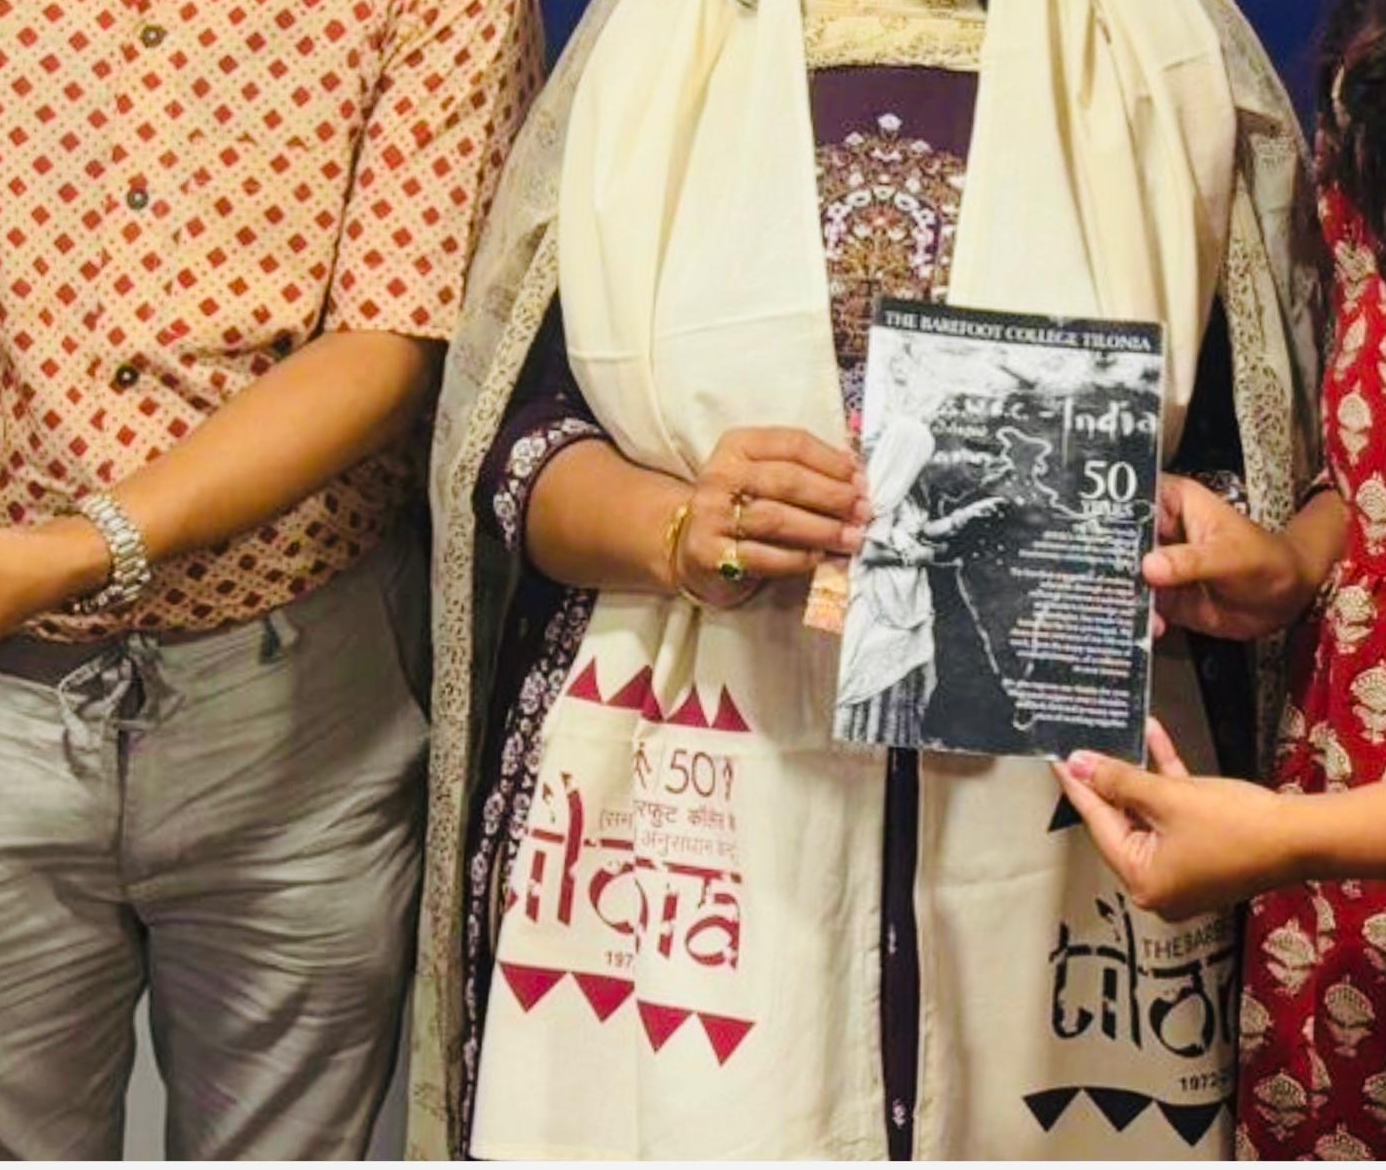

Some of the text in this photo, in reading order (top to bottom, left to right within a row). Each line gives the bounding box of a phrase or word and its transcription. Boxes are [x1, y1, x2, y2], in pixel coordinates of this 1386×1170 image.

[885, 310, 1152, 352] THE BAREFOOT COLLEGE TILONIA
[1078, 460, 1138, 503] 50
[665, 748, 716, 798] 50
